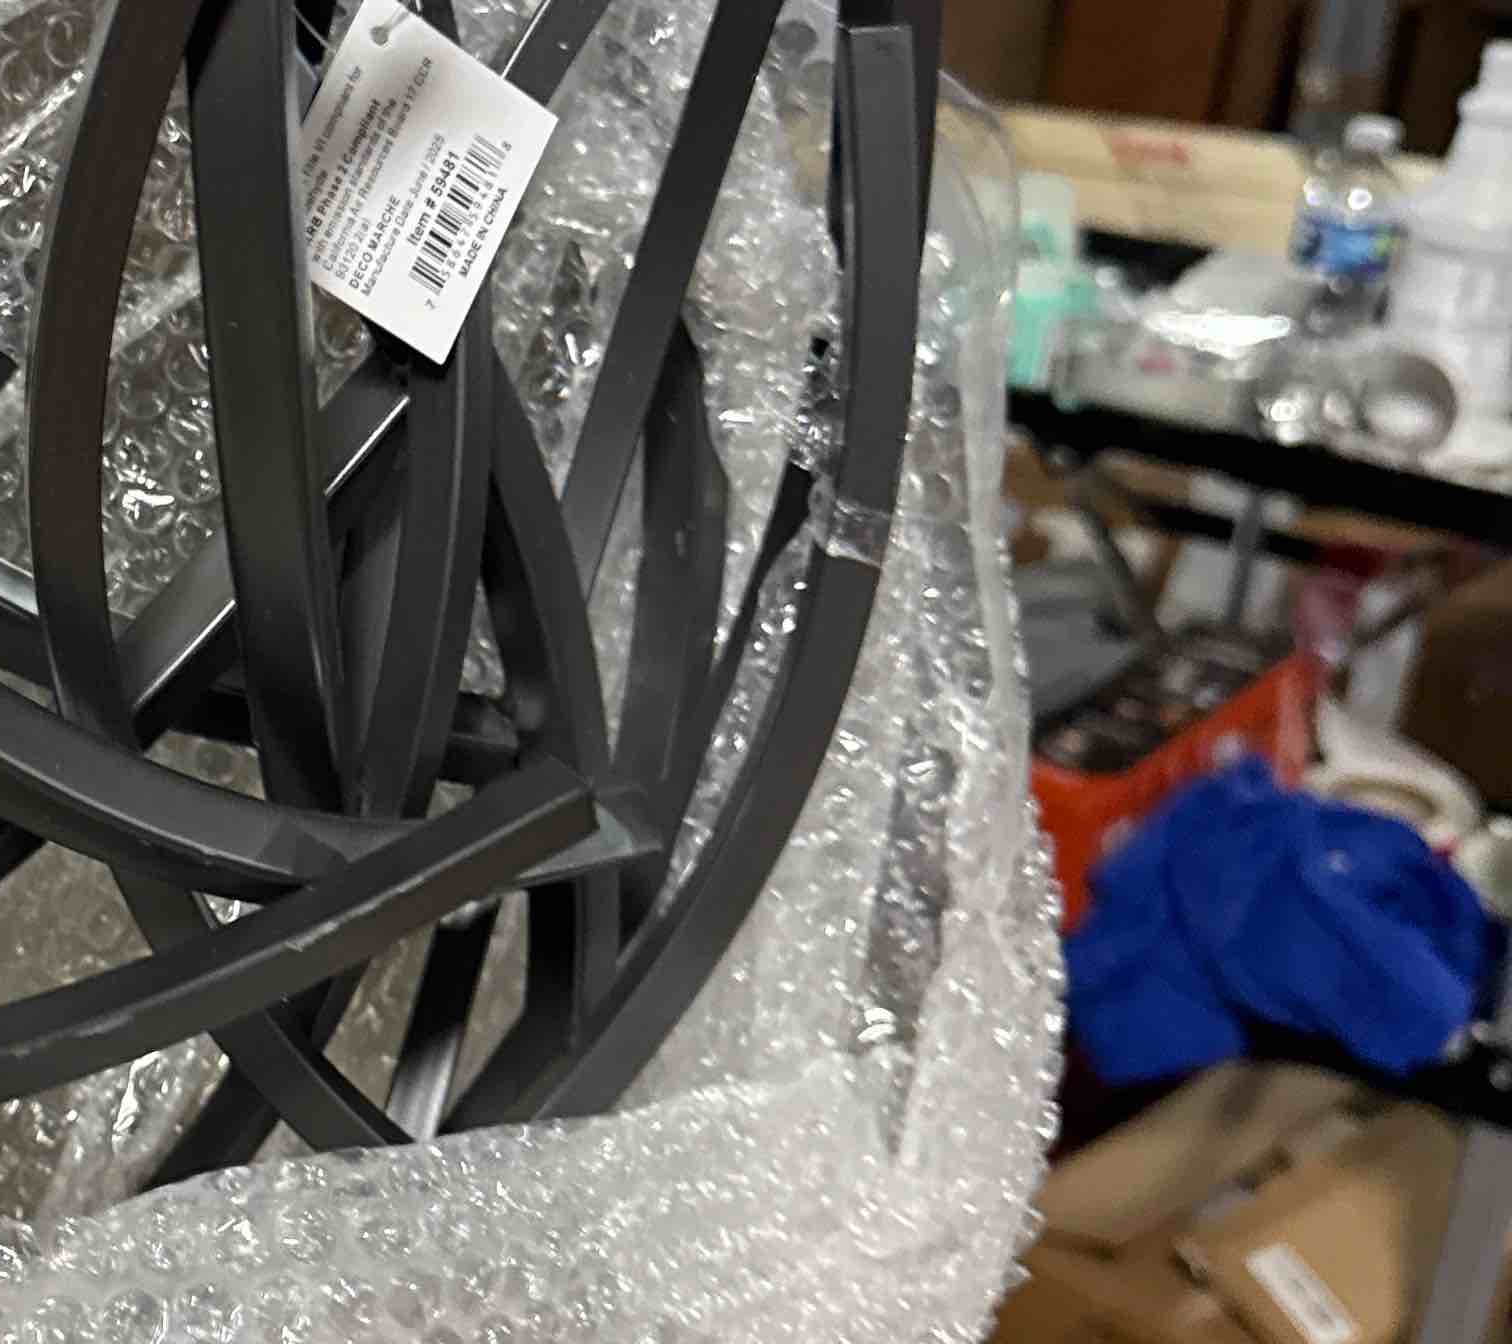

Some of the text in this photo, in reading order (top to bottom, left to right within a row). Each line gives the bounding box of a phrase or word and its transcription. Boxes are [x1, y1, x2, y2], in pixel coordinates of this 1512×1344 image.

[380, 97, 397, 118] the
[316, 173, 343, 216] Phase
[341, 97, 382, 166] Compliant
[321, 214, 356, 272] California
[356, 137, 394, 199] Resources
[403, 84, 418, 101] 17
[411, 55, 434, 87] CCR
[405, 149, 460, 246] Item # 59481
[347, 193, 401, 290] DECO MARCHE
[359, 225, 401, 297] Manufacture
[406, 168, 428, 199] June
[457, 184, 508, 278] MADE IN CHINA
